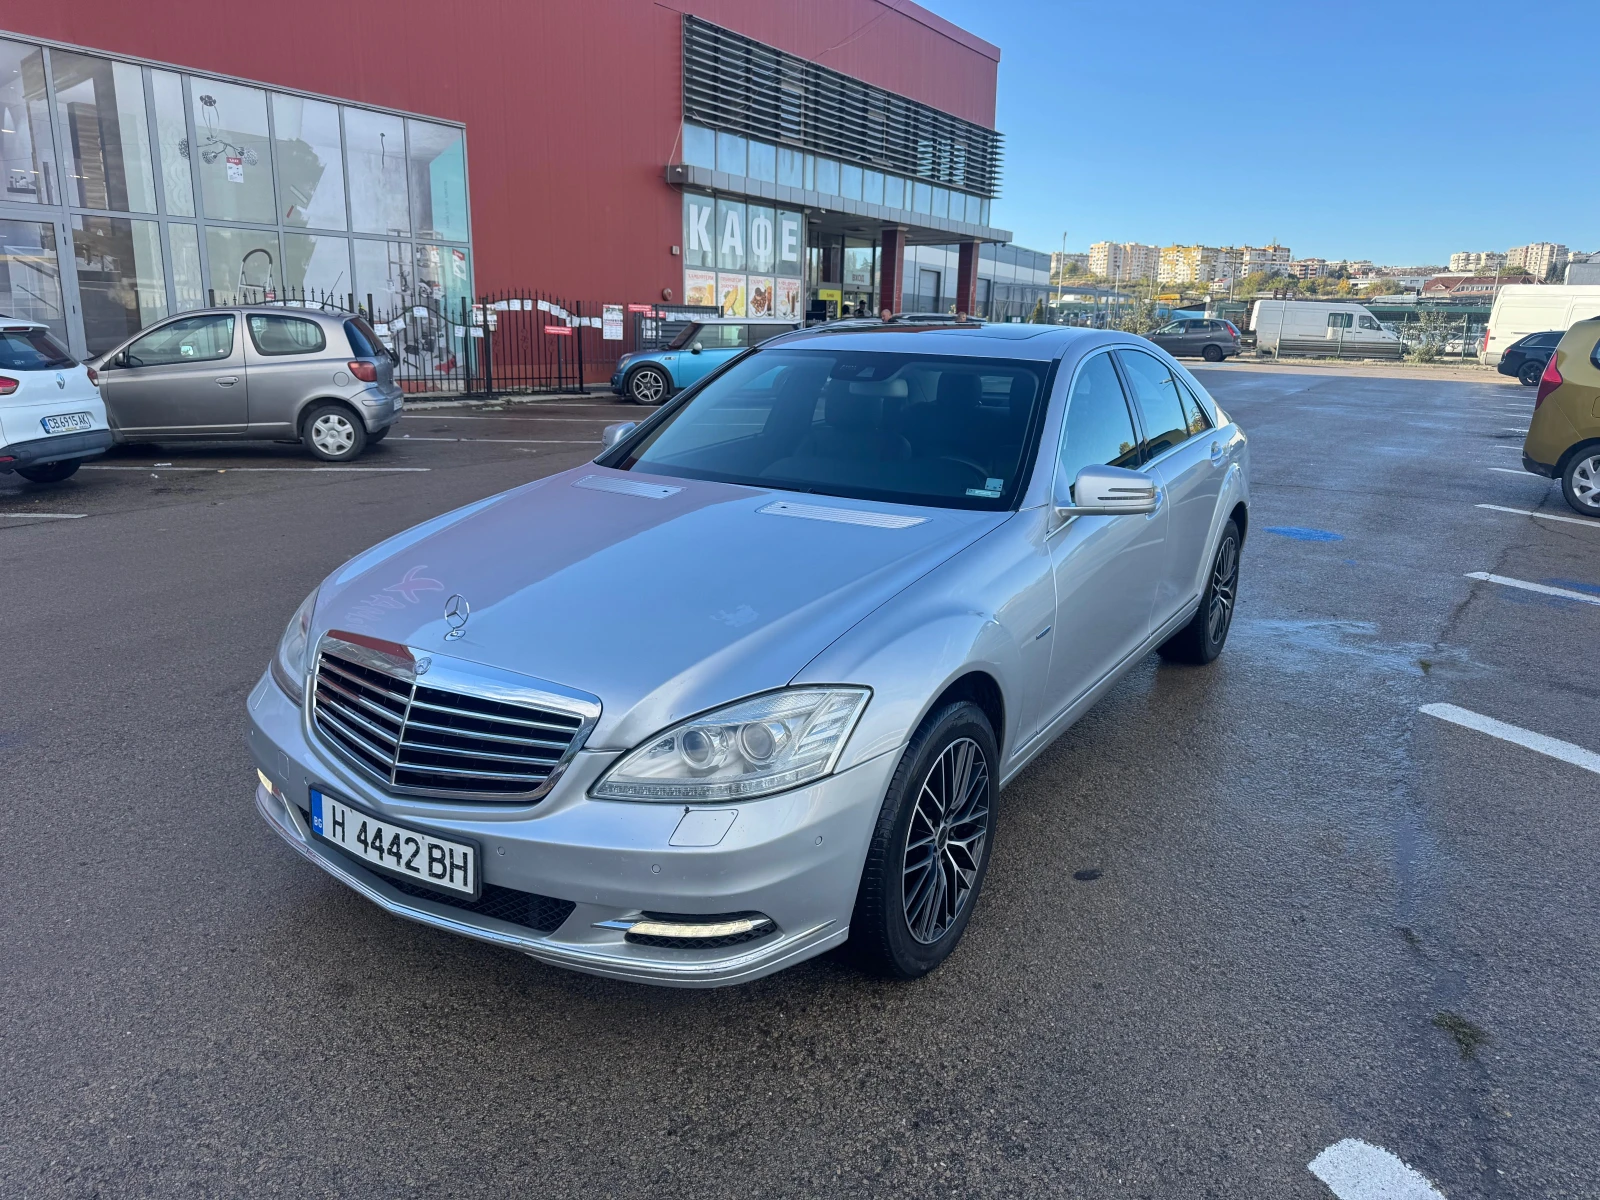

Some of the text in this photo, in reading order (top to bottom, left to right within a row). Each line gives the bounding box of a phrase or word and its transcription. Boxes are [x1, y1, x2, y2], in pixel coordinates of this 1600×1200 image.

[689, 203, 798, 263] КАФЕ
[852, 274, 865, 283] ВХОД
[47, 414, 88, 429] CB 6915 AK
[313, 816, 323, 828] BG
[332, 804, 468, 888] H 4442 BH
